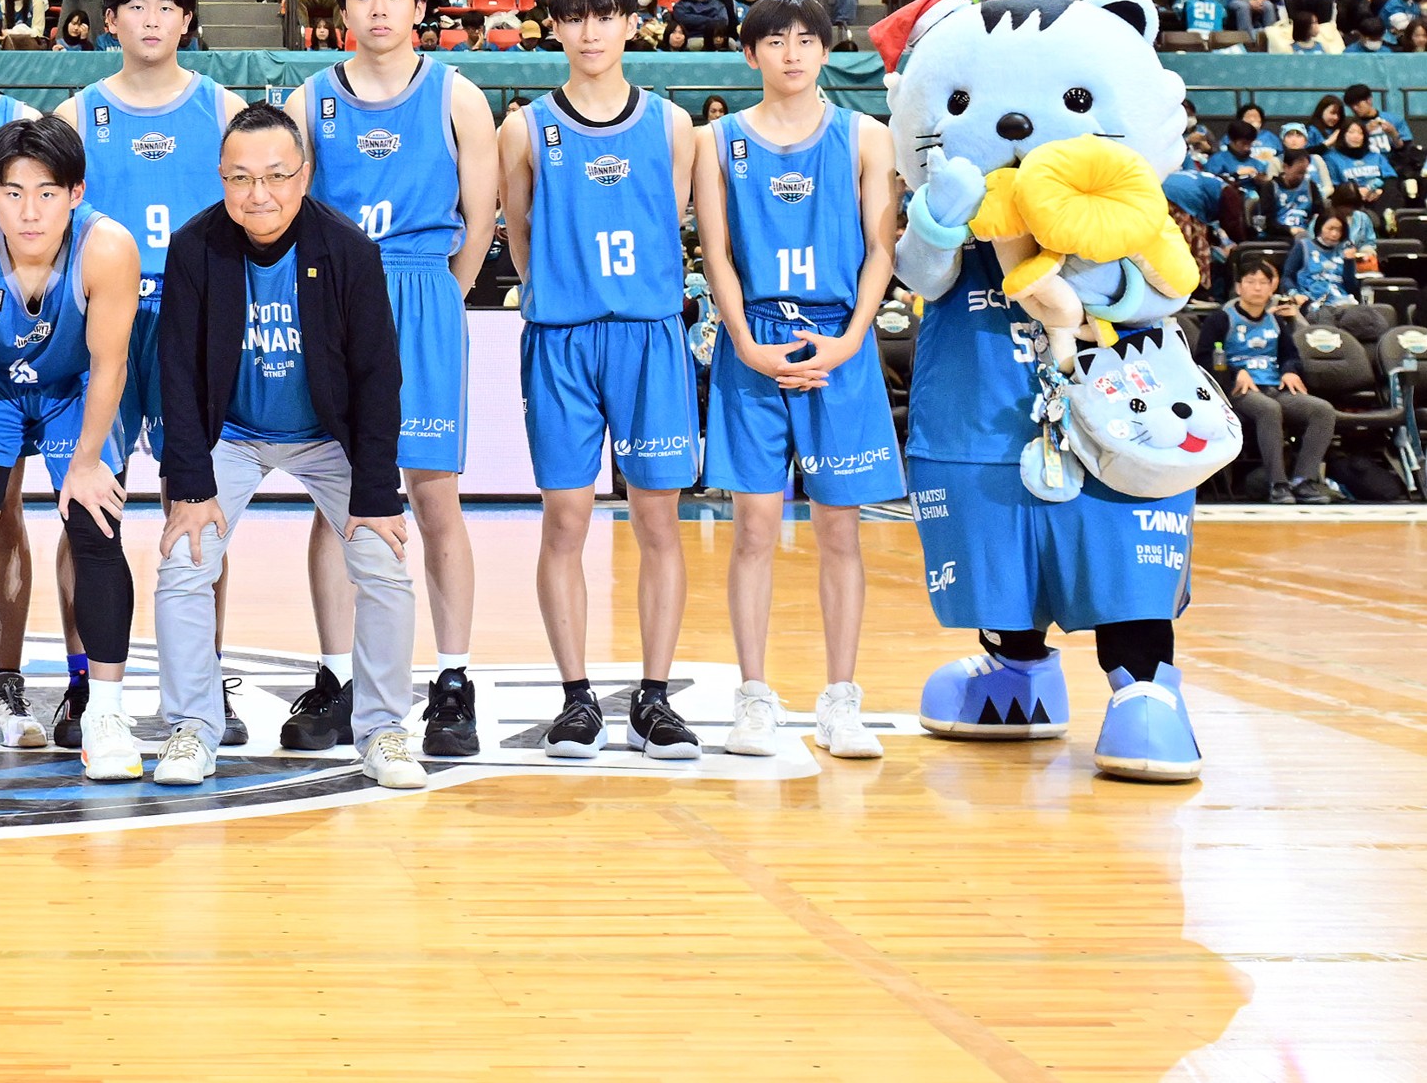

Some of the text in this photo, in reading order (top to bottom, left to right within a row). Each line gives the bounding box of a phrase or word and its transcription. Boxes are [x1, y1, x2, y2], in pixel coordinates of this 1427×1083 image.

[271, 92, 282, 104] 13
[587, 162, 628, 177] HANNARYZ
[772, 180, 812, 194] HANNARYZ
[146, 204, 170, 248] 9
[359, 200, 392, 241] 10
[596, 230, 636, 277] 13
[776, 245, 816, 290] 14
[249, 302, 293, 323] KOTO
[277, 359, 295, 370] CLUB
[632, 435, 690, 452] ハンナリCH
[819, 446, 891, 469] ハンナリCHE
[833, 467, 854, 475] ENERGY
[918, 488, 946, 504] MATSU
[922, 504, 950, 520] SHIMA
[1136, 544, 1163, 555] DRUG
[1137, 555, 1163, 565] STORE
